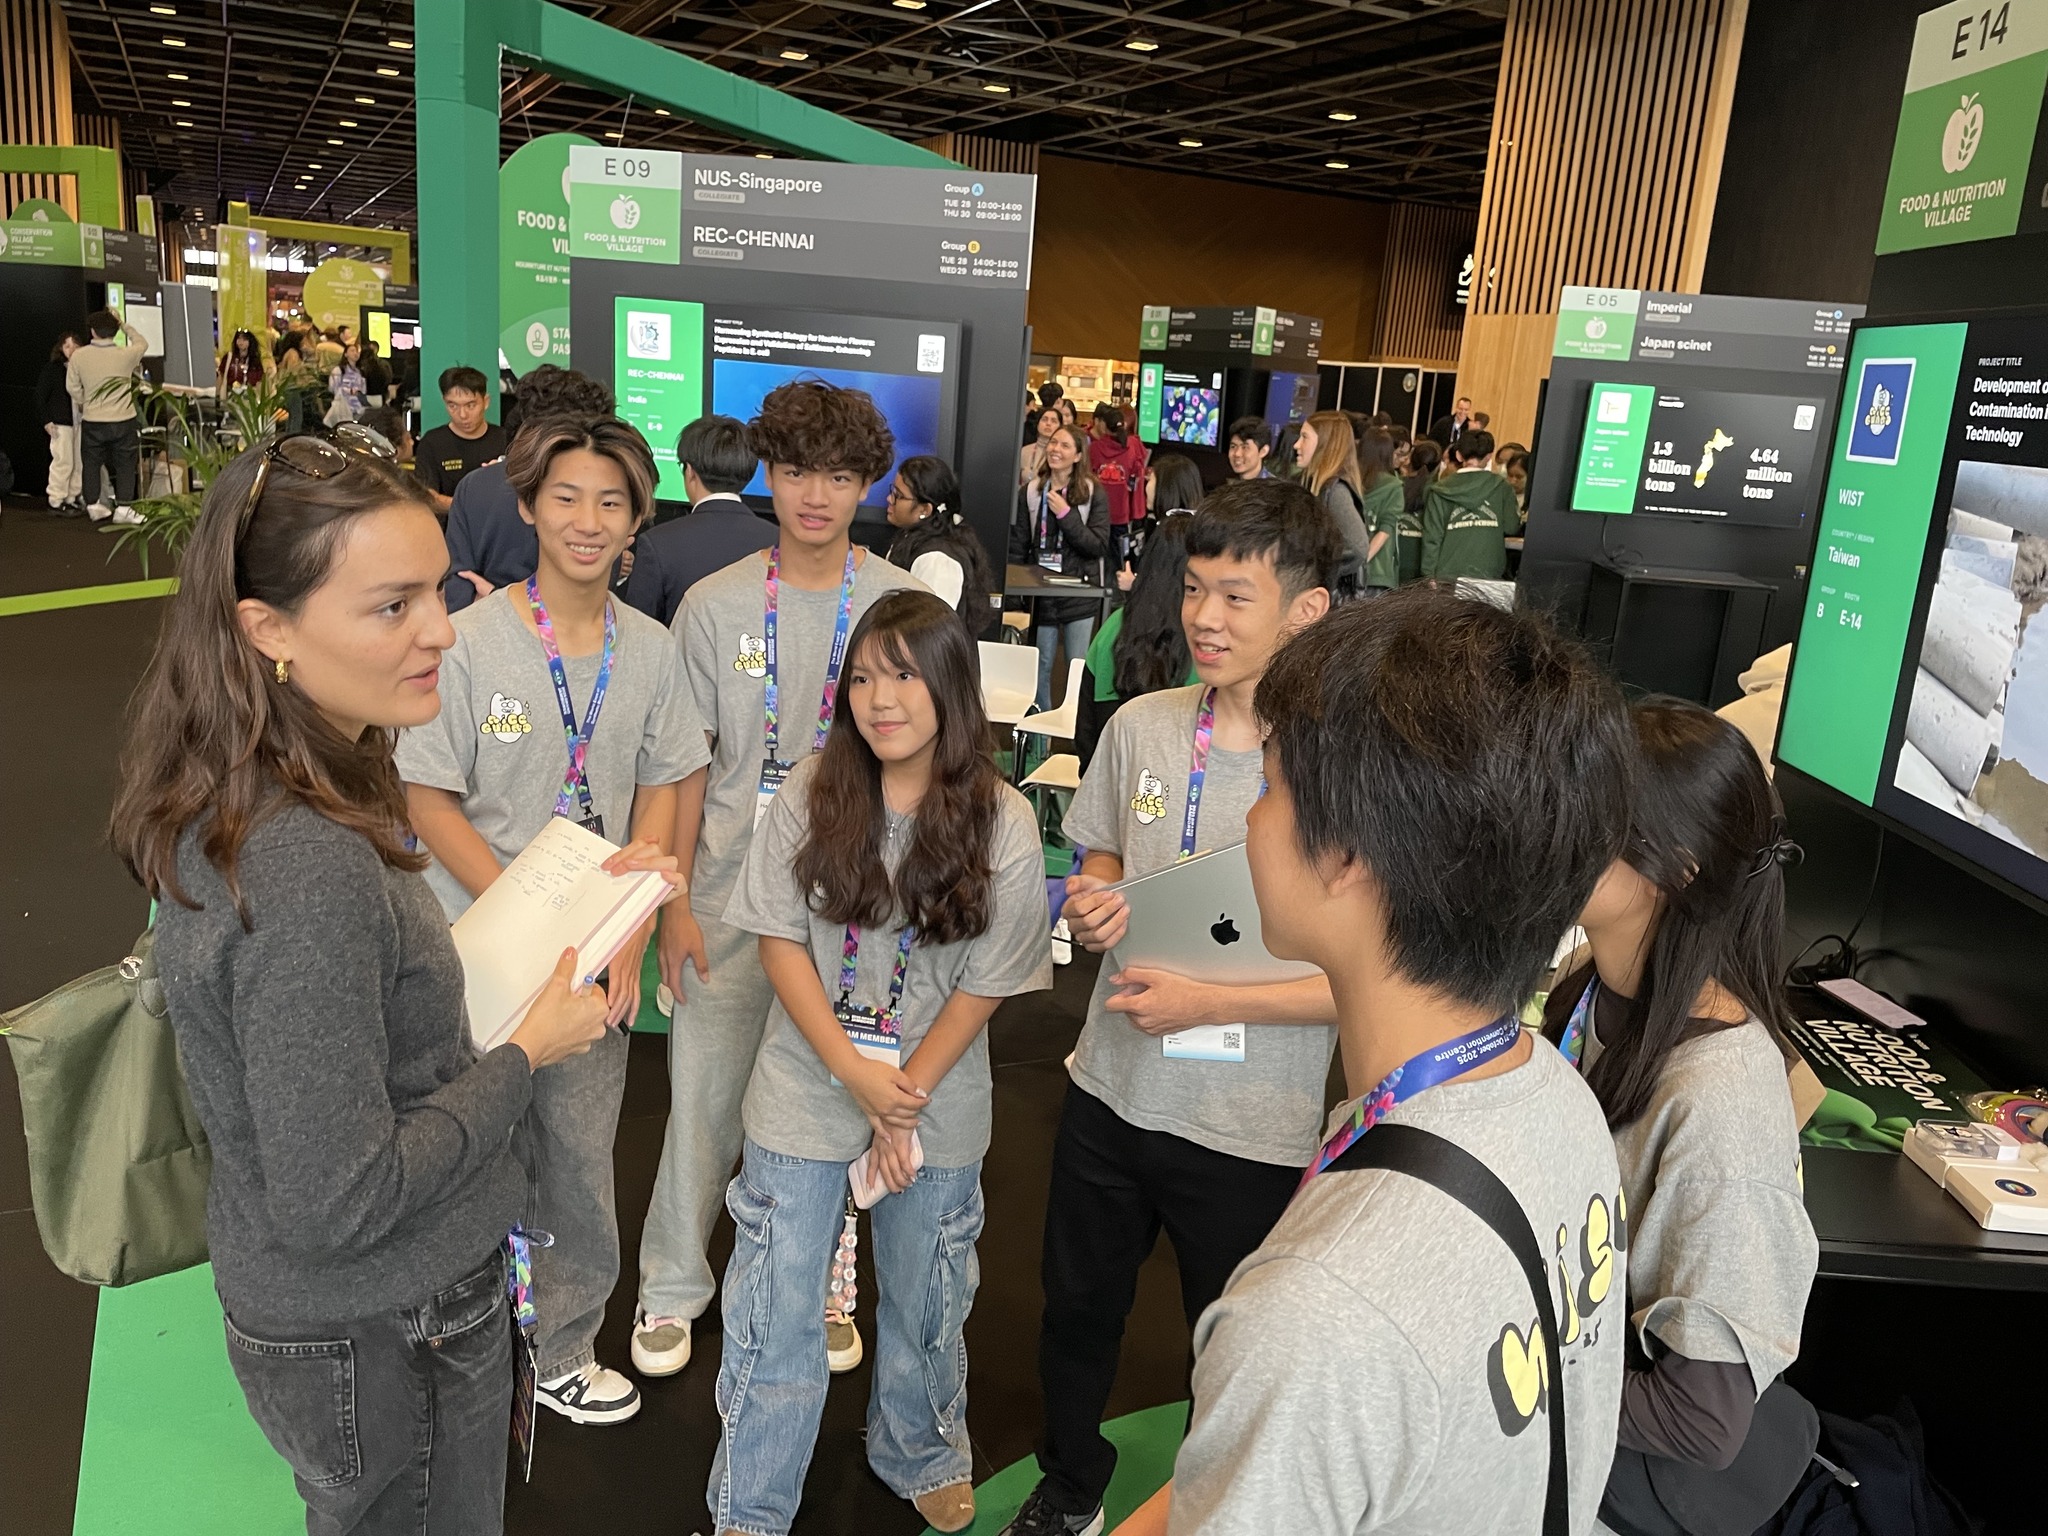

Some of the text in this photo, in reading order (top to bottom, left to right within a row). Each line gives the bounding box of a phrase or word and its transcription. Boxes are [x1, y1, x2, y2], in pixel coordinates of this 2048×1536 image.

[1952, 1, 2011, 61] E 14
[605, 158, 651, 178] E 09
[694, 168, 823, 195] NUS-Singapore
[944, 183, 970, 195] Group
[944, 199, 959, 207] TUE
[1900, 178, 2007, 214] FOOD & NUTRITION
[518, 210, 567, 232] FOOD &
[944, 209, 959, 217] THU
[1924, 205, 1972, 228] VILLAGE
[584, 232, 666, 246] FOOD & NUTRITION
[693, 226, 815, 250] REC-CHENNAI
[941, 240, 966, 252] Group
[606, 243, 644, 253] VILLAGE
[941, 256, 955, 264] TUE
[940, 266, 957, 274] WED
[1586, 294, 1618, 307] E 05
[1647, 300, 1693, 314] Imperial
[1640, 336, 1712, 352] Japan scinet
[1978, 357, 2023, 366] PROJECT TITLE
[628, 368, 685, 381] REC-CHENNAI
[1973, 377, 2042, 397] Development
[628, 395, 648, 404] India
[1969, 401, 2044, 420] Contamination
[1965, 425, 2024, 447] Technology
[1652, 441, 1674, 456] 1.3
[1750, 448, 1779, 464] 4.64
[1648, 458, 1691, 475] billion
[1745, 466, 1793, 483] million
[1645, 477, 1675, 492] tons
[1743, 484, 1774, 500] tons
[1838, 488, 1864, 508] WIST
[1828, 546, 1861, 568] Taiwan
[1816, 602, 1863, 630] B E-14
[843, 1029, 897, 1045] AM MEMBER
[1434, 1027, 1505, 1062] Convention Centre
[1479, 1037, 1504, 1054] October,
[1805, 1019, 1897, 1088] VILLAGE
[1457, 1051, 1478, 1065] 2025
[1832, 1020, 1953, 1112] NUTRITION
[1915, 1070, 1947, 1085] &
